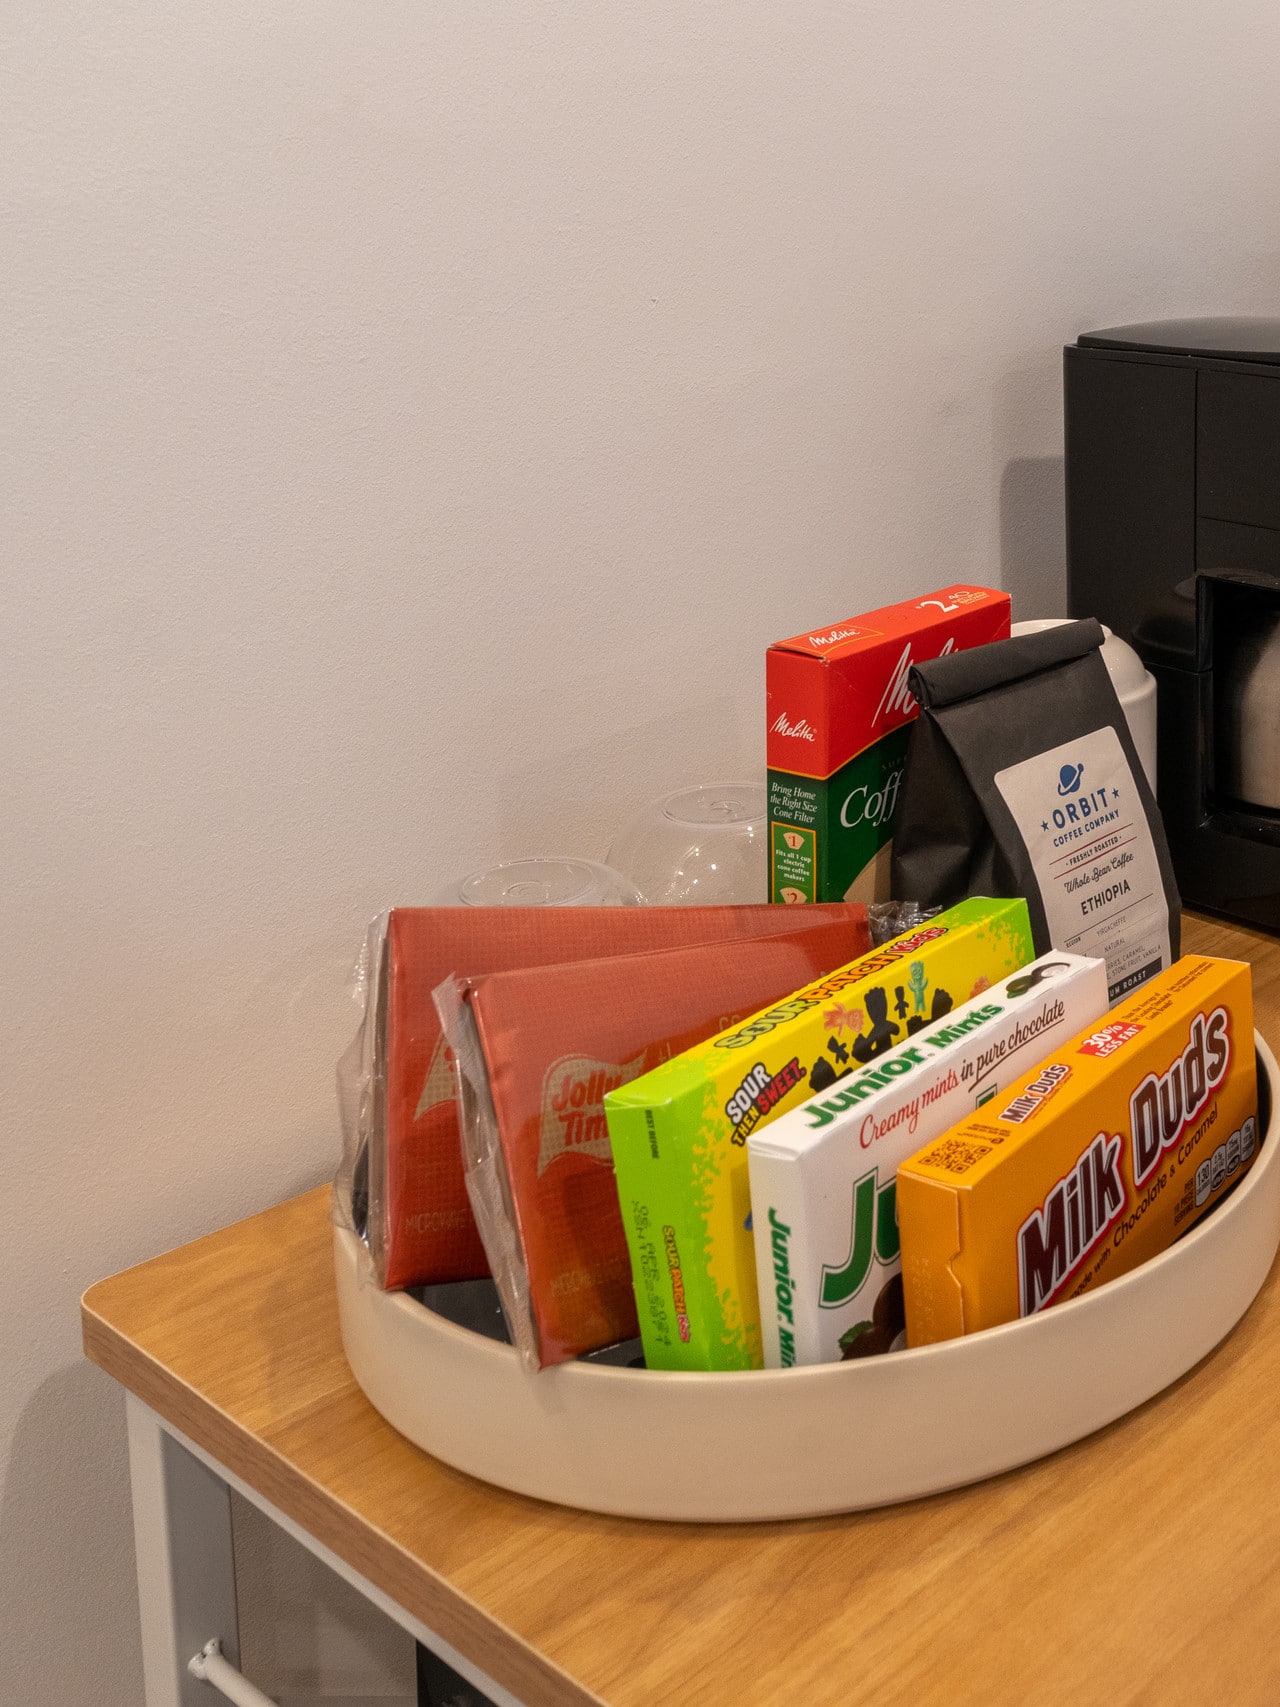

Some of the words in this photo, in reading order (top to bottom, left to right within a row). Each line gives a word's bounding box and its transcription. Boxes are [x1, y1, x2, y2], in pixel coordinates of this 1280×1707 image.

[809, 628, 860, 648] Melitta
[769, 712, 816, 742] Melitta
[770, 794, 782, 805] the
[782, 796, 801, 811] Right
[802, 801, 818, 813] Size
[772, 782, 792, 797] Bring
[793, 787, 817, 800] Home
[1052, 788, 1108, 829] ORBIT
[773, 807, 793, 819] Cone
[794, 811, 815, 823] Filter
[1053, 827, 1084, 848] COFFEE
[1084, 809, 1120, 833] COMPANY
[775, 850, 786, 858] Fits
[786, 851, 796, 859] all
[777, 864, 791, 872] cone
[792, 867, 810, 876] coffee
[783, 858, 805, 868] electric
[1069, 848, 1093, 866] FRESHLY
[1094, 836, 1119, 854] ROASTED
[783, 873, 805, 882] makers
[1064, 873, 1091, 893] Whole
[1091, 865, 1111, 882] Bean
[1111, 851, 1134, 869] Coffee
[1081, 879, 1131, 916] ETHIOPIA
[1123, 970, 1146, 990] ROAST
[714, 999, 820, 1049] SOUR
[798, 953, 904, 1001] PATCH
[1082, 1025, 1123, 1049] 30%
[1095, 1040, 1123, 1057] LESS
[803, 1047, 928, 1129] Junior
[925, 1004, 1004, 1048] Mints
[859, 1104, 921, 1149] Creamy
[922, 1069, 959, 1109] mints
[961, 1059, 974, 1081] in
[976, 1040, 1006, 1080] pure
[1008, 999, 1065, 1050] chocolate
[725, 1062, 774, 1126] SOUR
[731, 1108, 761, 1147] THEN
[756, 1056, 807, 1116] SWEET.
[998, 1094, 1044, 1124] Milk
[1024, 1064, 1070, 1095] Duds
[1017, 1132, 1125, 1320] Milk
[1130, 1007, 1229, 1187] Duds
[1094, 1247, 1111, 1272] with
[1113, 1173, 1167, 1248] Chocolate
[1169, 1164, 1176, 1177] &
[1177, 1102, 1218, 1165] Caramel
[662, 1225, 680, 1268] SOUR
[768, 1206, 797, 1326] Junior
[669, 1268, 686, 1313] PATCH
